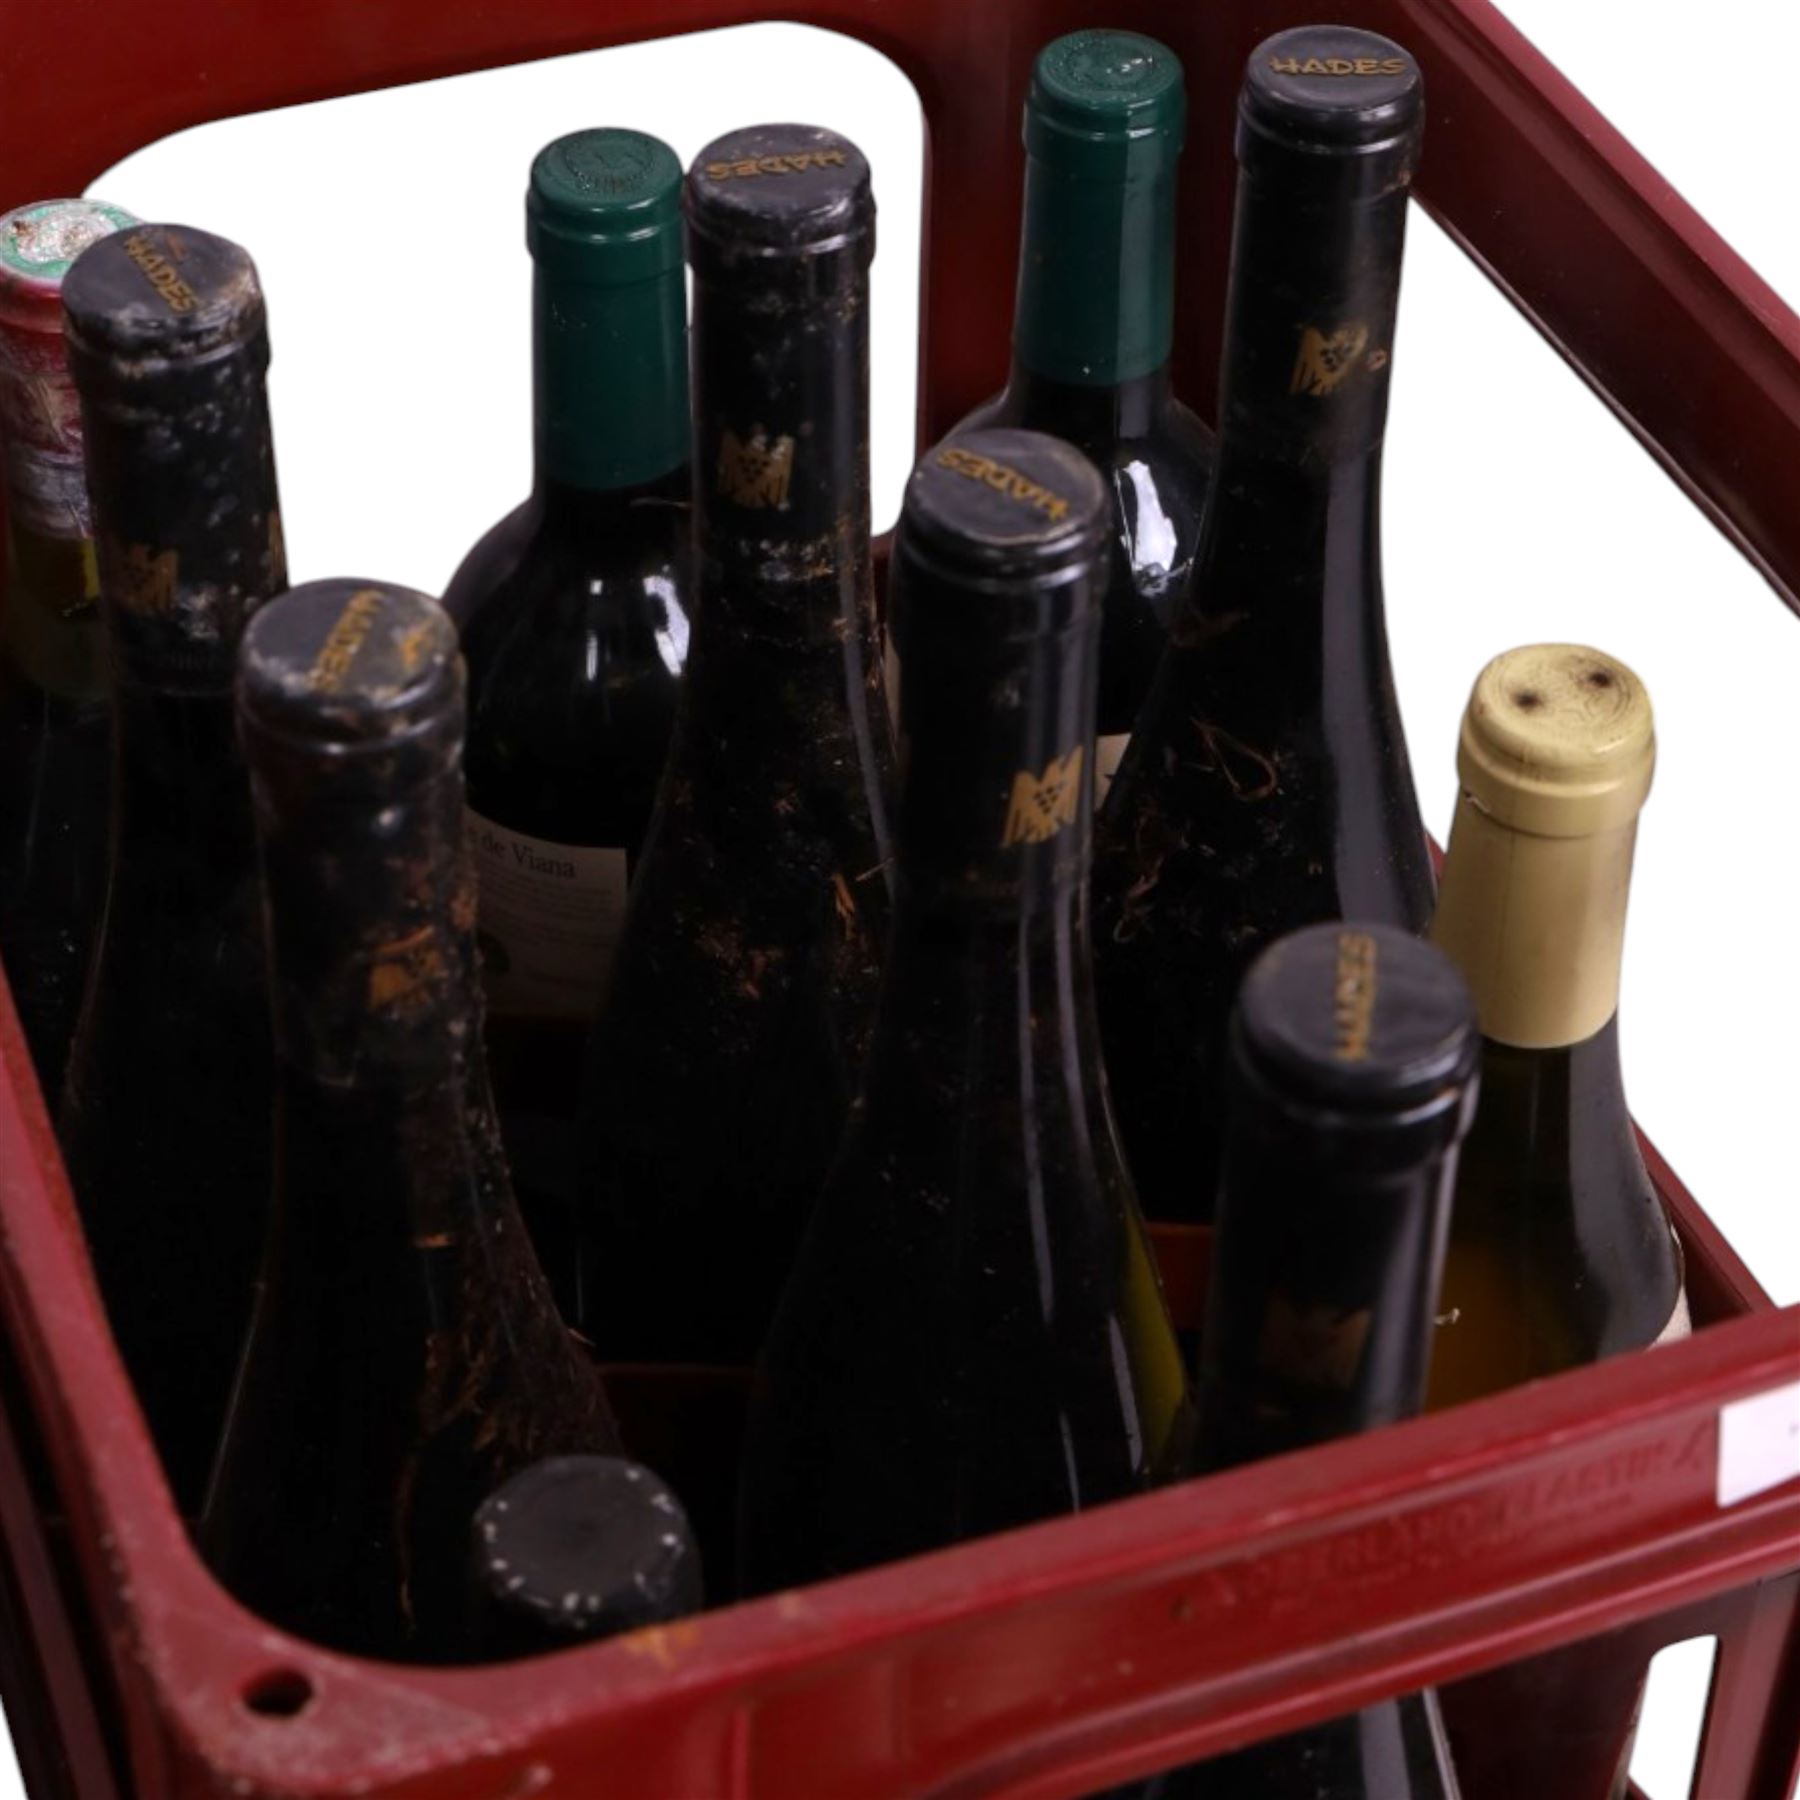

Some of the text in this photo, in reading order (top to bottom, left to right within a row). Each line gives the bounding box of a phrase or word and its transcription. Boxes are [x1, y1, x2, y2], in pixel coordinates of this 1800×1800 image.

[1267, 54, 1406, 77] HADES
[706, 149, 847, 181] HADES
[123, 235, 199, 313] HADES
[936, 448, 1072, 523] HADES
[305, 587, 385, 692] HADES
[481, 831, 576, 879] de Viana
[1335, 934, 1378, 1063] HADES
